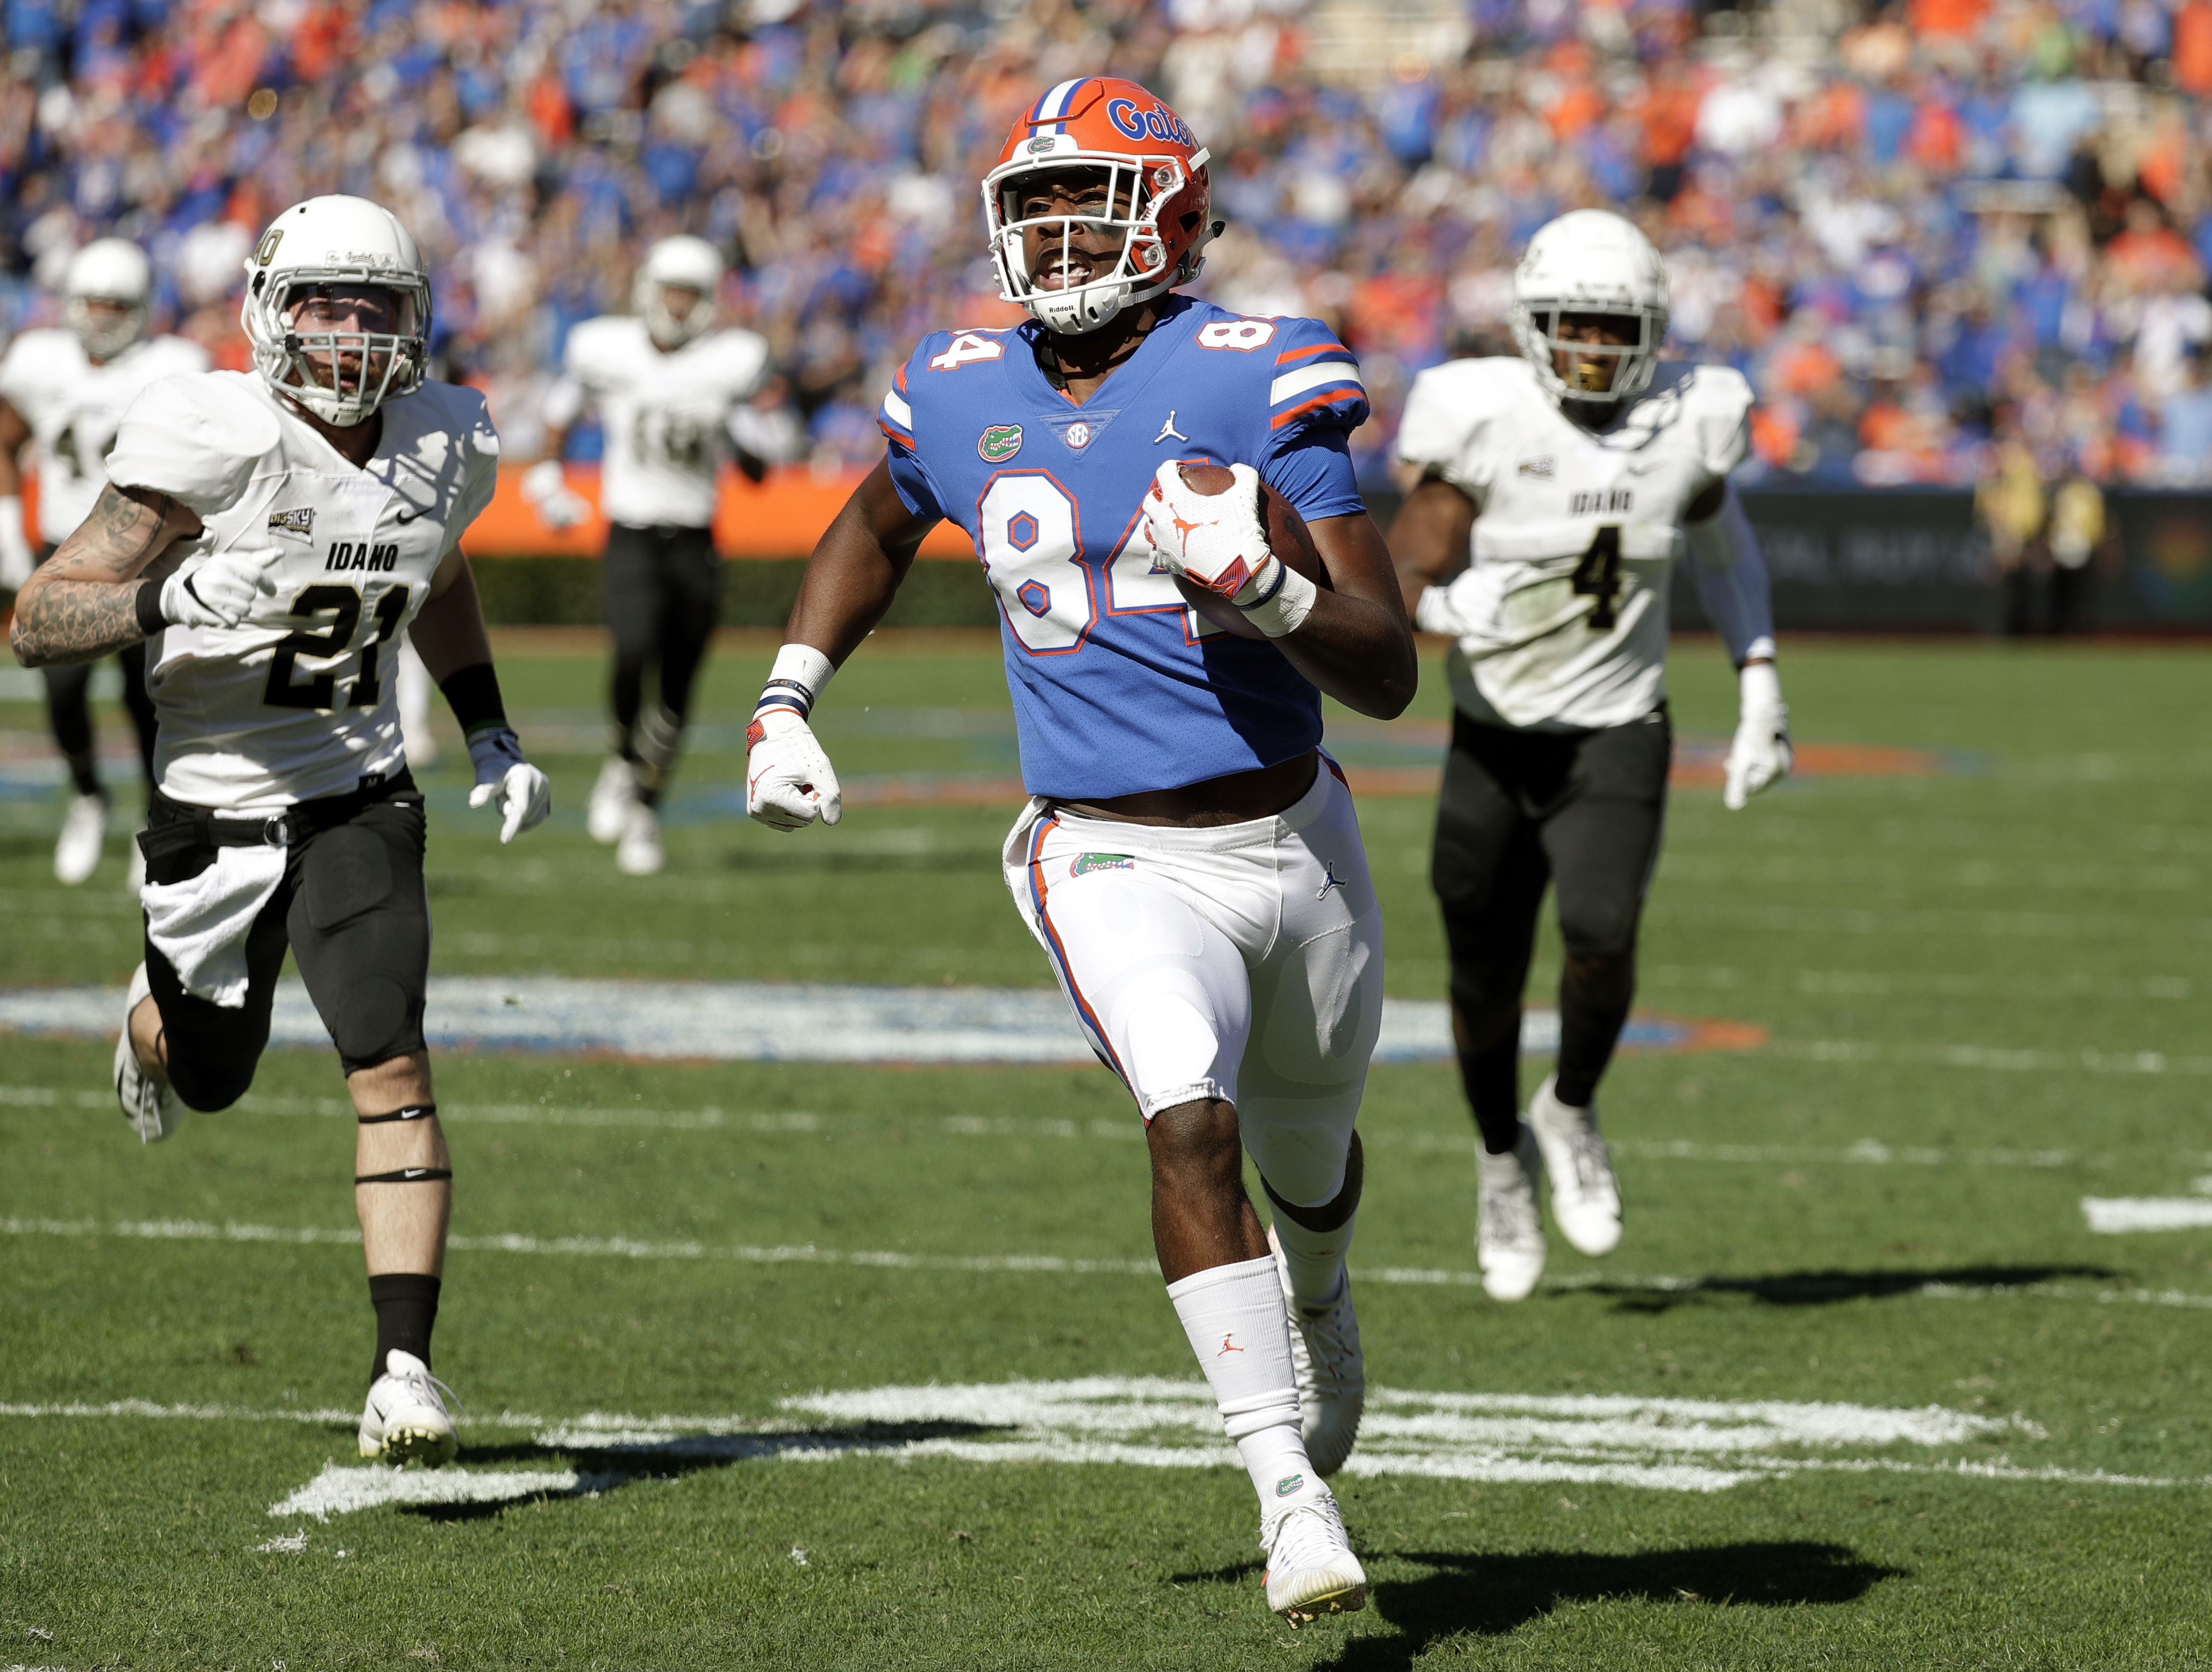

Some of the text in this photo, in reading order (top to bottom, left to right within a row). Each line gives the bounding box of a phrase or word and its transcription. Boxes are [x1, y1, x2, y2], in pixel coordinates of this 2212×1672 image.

[1048, 304, 1074, 313] Riddell
[1066, 423, 1089, 446] SEC
[287, 508, 310, 526] SKY
[325, 543, 399, 571] IDAHO
[1570, 523, 1622, 630] 4
[262, 582, 411, 710] 21
